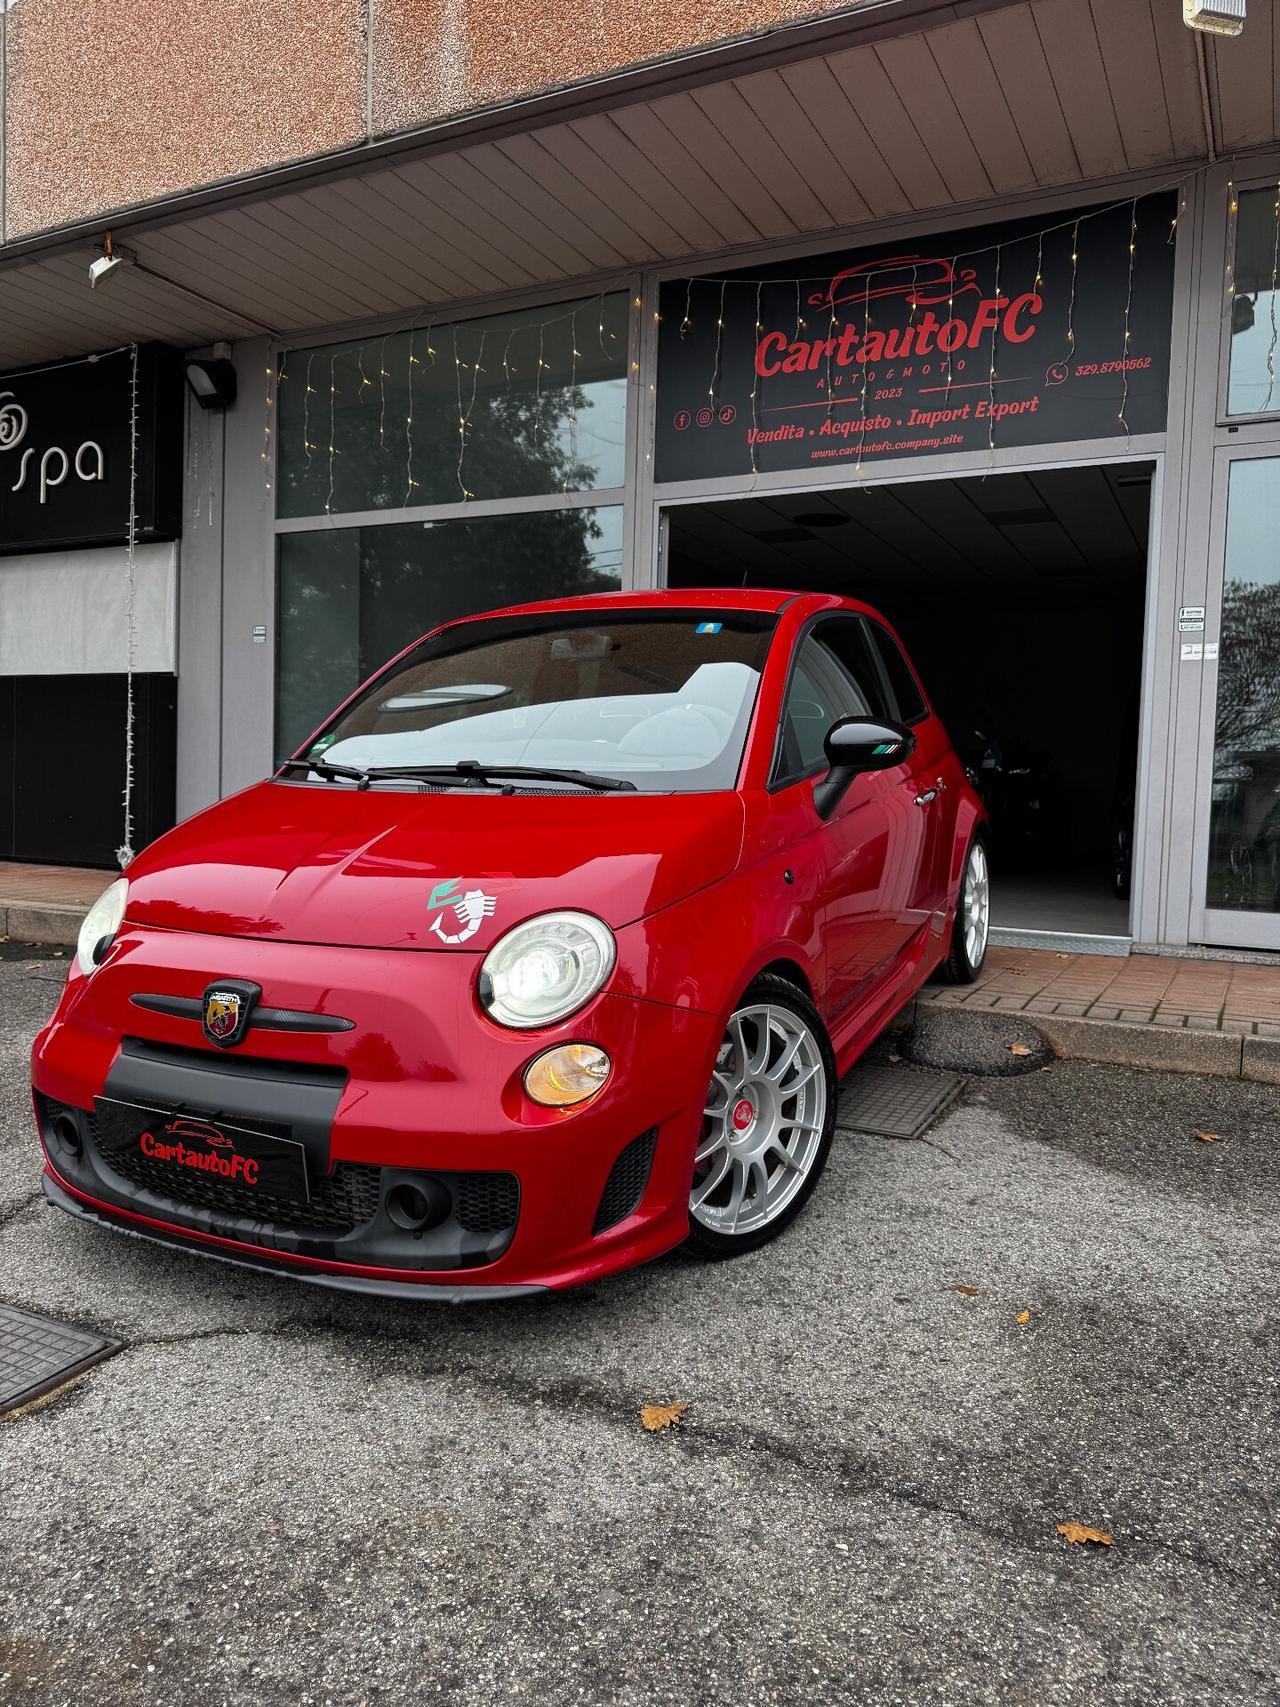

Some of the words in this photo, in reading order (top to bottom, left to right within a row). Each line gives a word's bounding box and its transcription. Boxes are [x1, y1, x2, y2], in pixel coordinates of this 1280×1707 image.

[755, 293, 1042, 377] CartautoFC
[1075, 357, 1152, 376] 329.8790562
[874, 386, 904, 400] 2023
[746, 424, 804, 445] Vendita
[819, 414, 892, 438] Acquisto
[907, 403, 970, 428] Import
[974, 395, 1039, 421] Export
[11, 440, 104, 504] spa
[139, 1132, 260, 1185] CartautoFC
